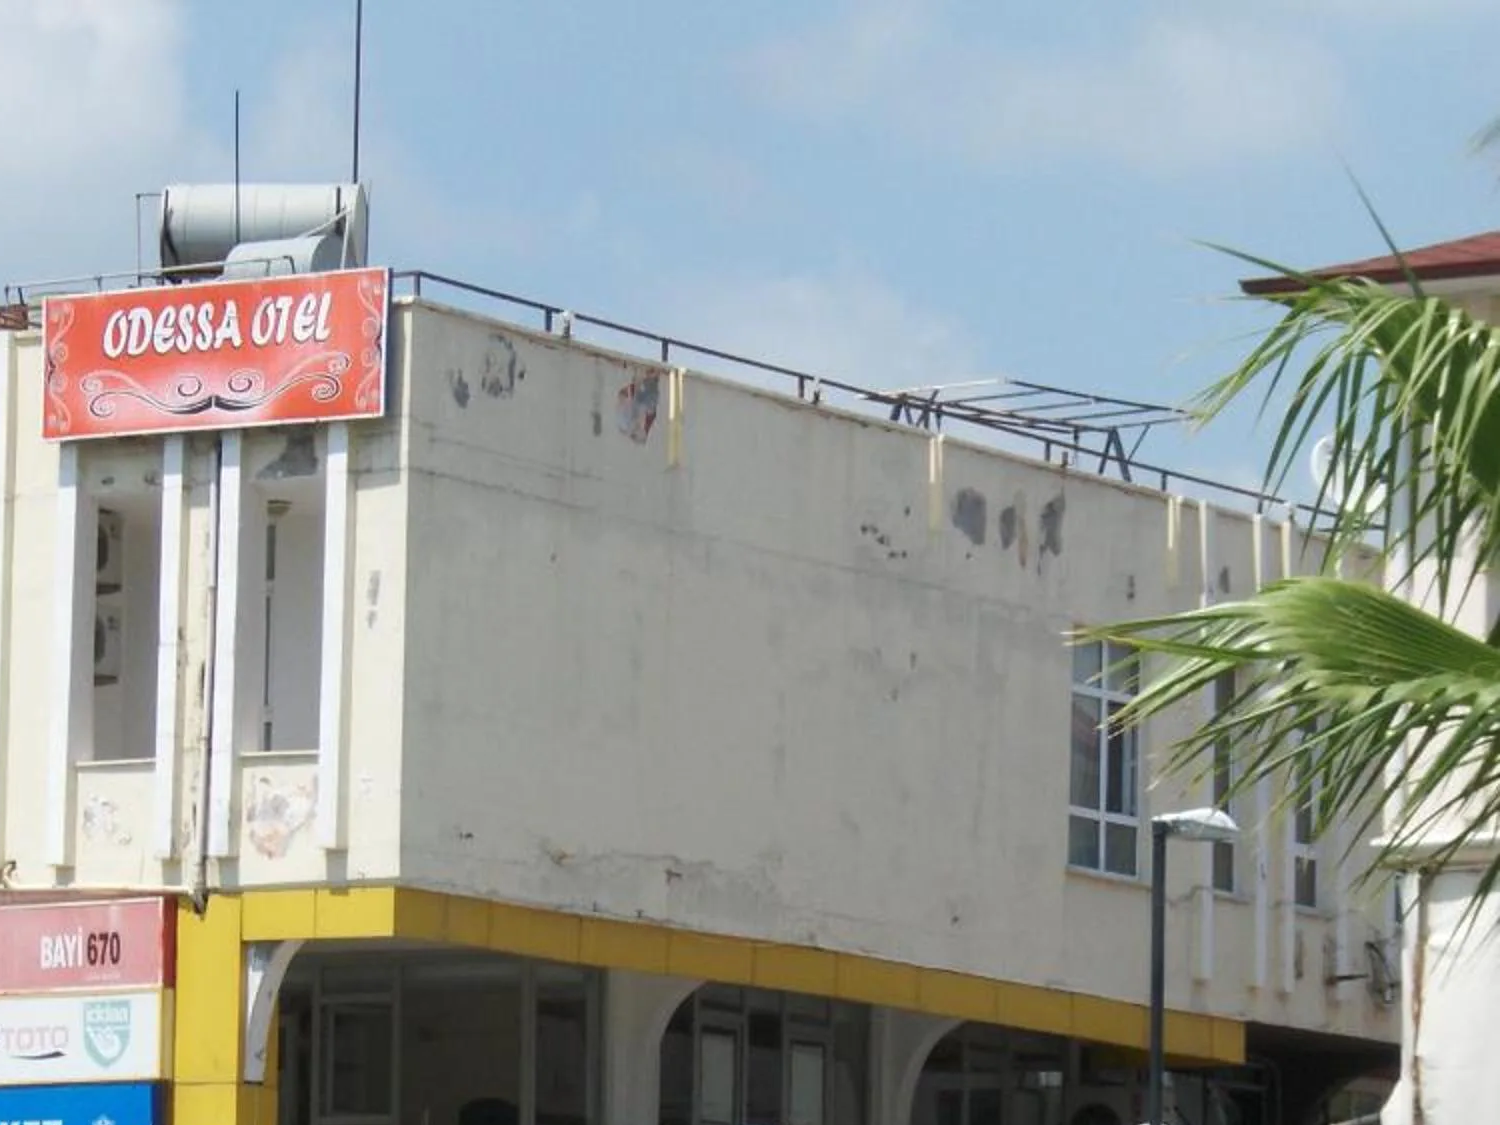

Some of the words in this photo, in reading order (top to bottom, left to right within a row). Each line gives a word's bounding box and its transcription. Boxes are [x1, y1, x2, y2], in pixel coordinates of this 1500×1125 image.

[102, 298, 243, 359] ODESSA
[40, 926, 83, 969] BAYİ
[87, 931, 122, 966] 670
